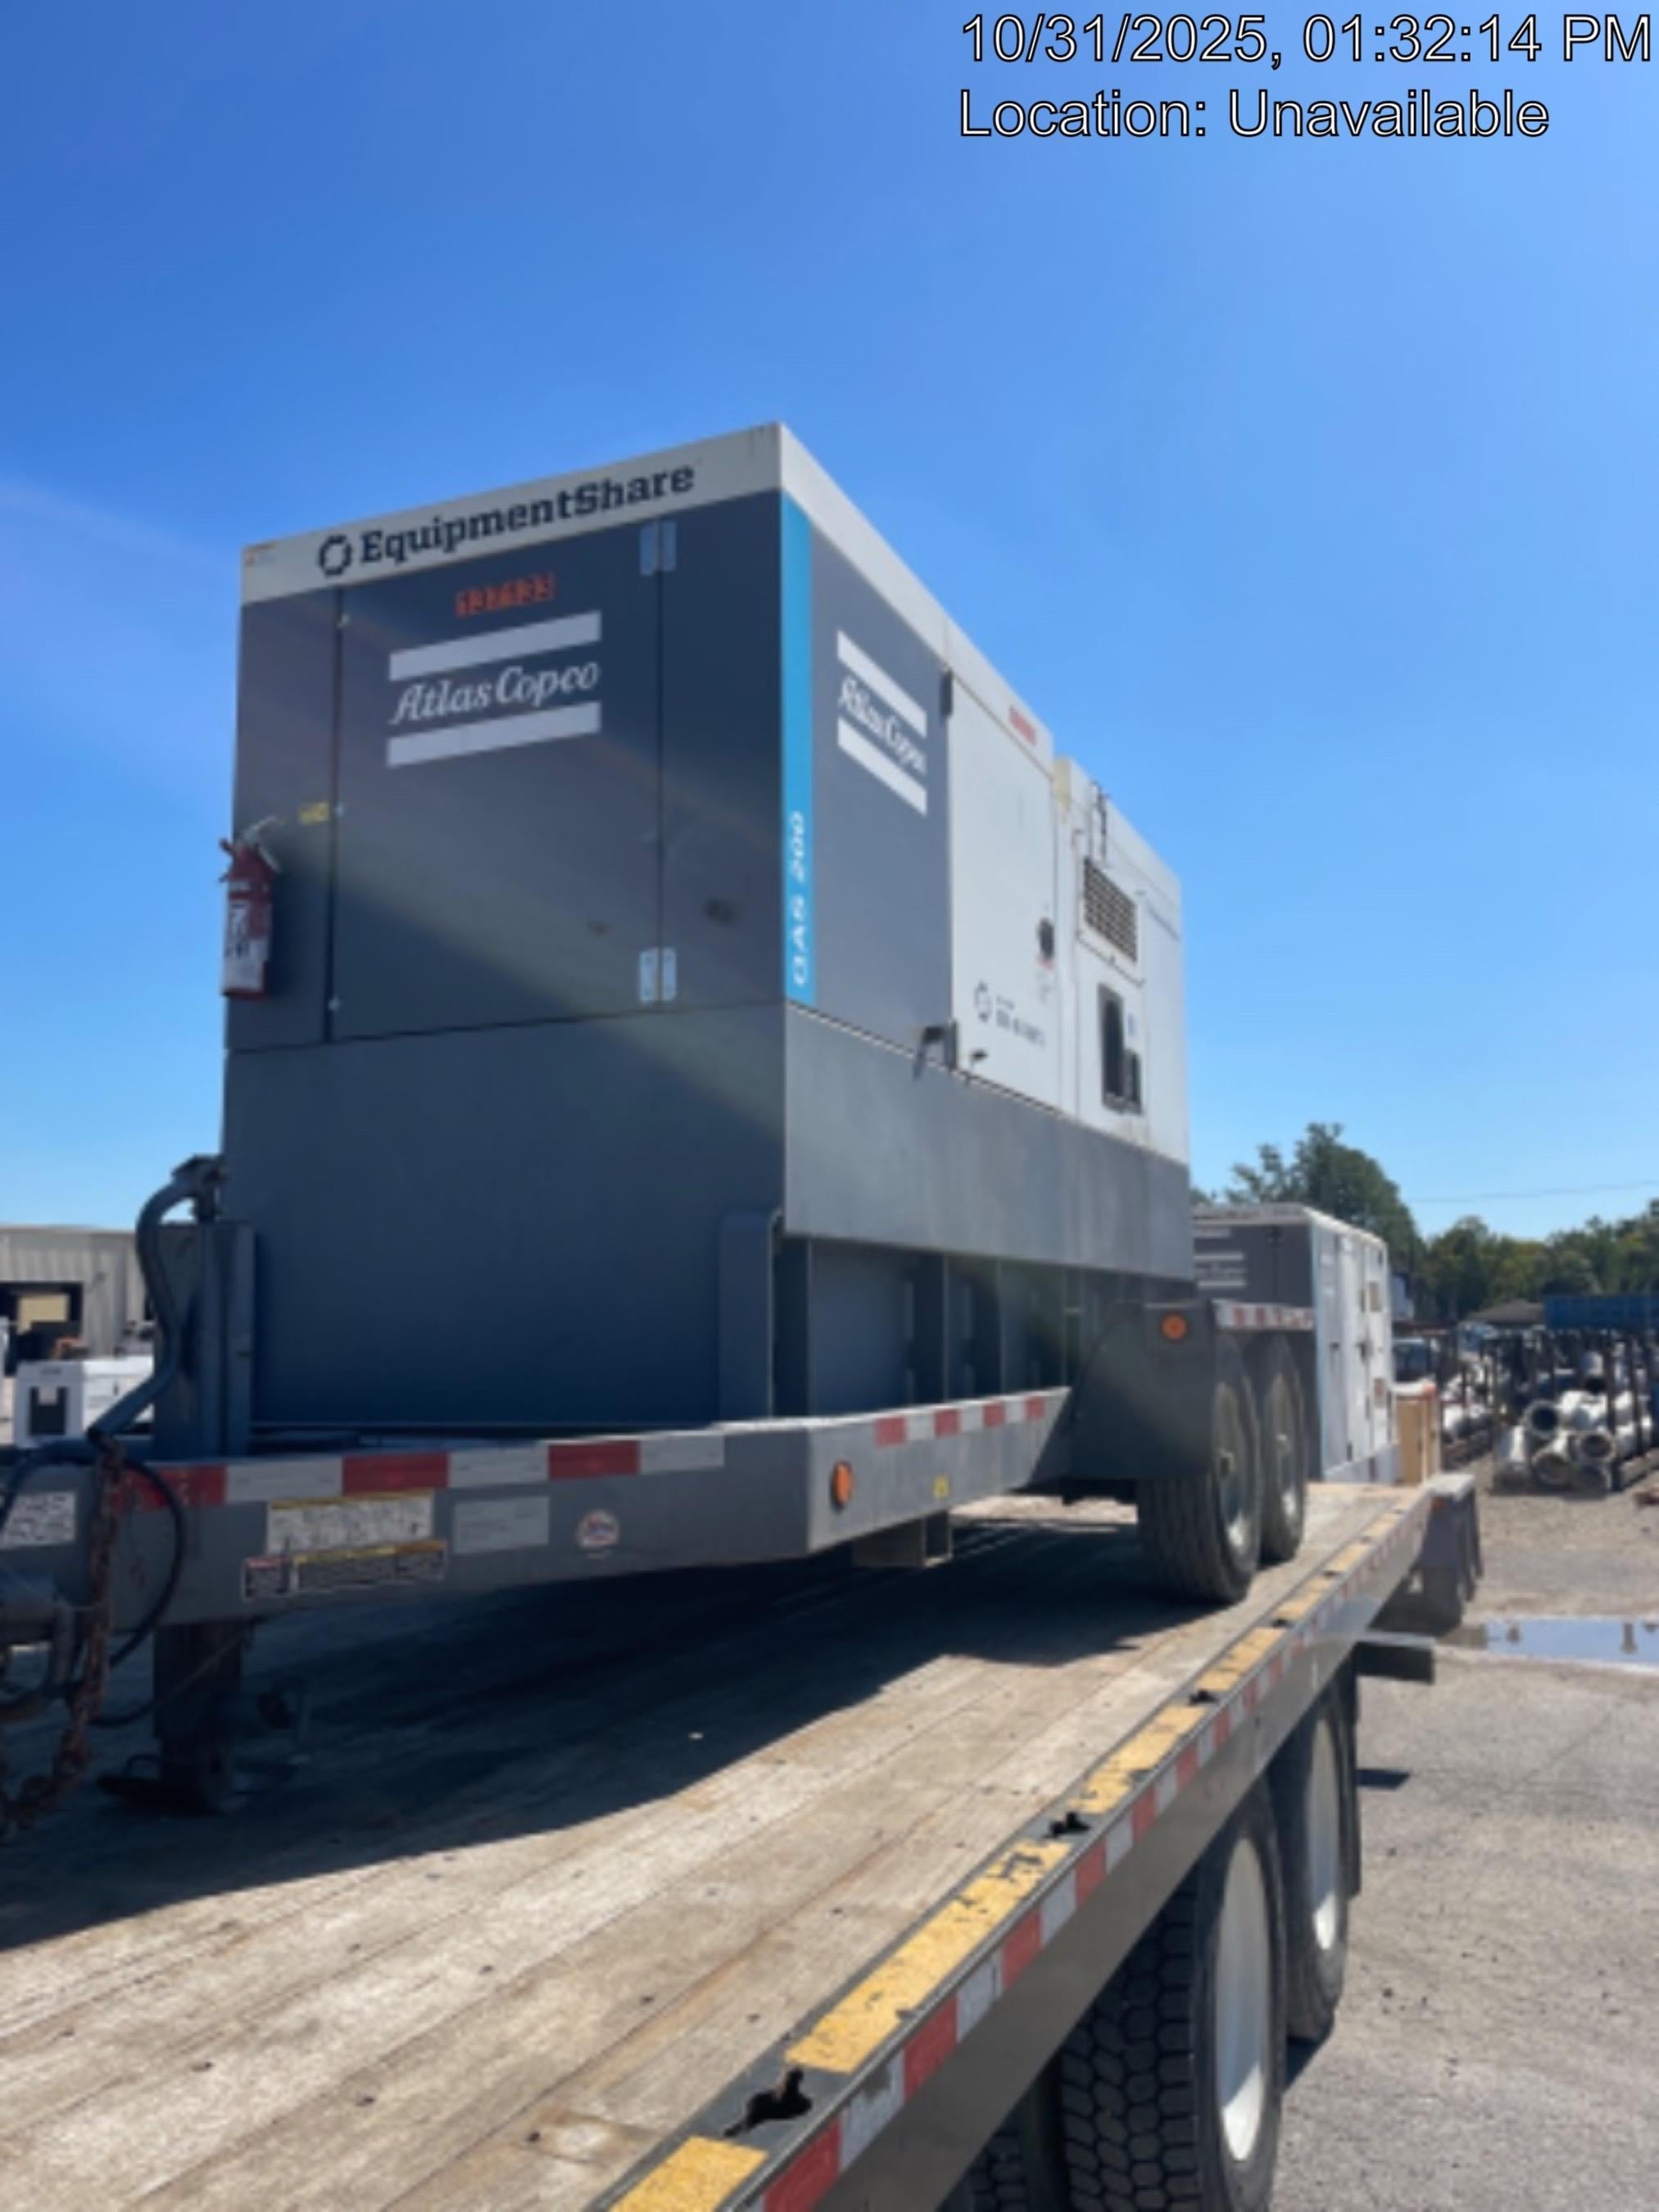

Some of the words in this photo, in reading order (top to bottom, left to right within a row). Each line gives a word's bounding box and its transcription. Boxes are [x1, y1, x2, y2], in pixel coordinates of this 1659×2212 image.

[359, 465, 696, 564] EquipmentShare
[388, 679, 492, 725] Atlas
[495, 661, 599, 708] Copco
